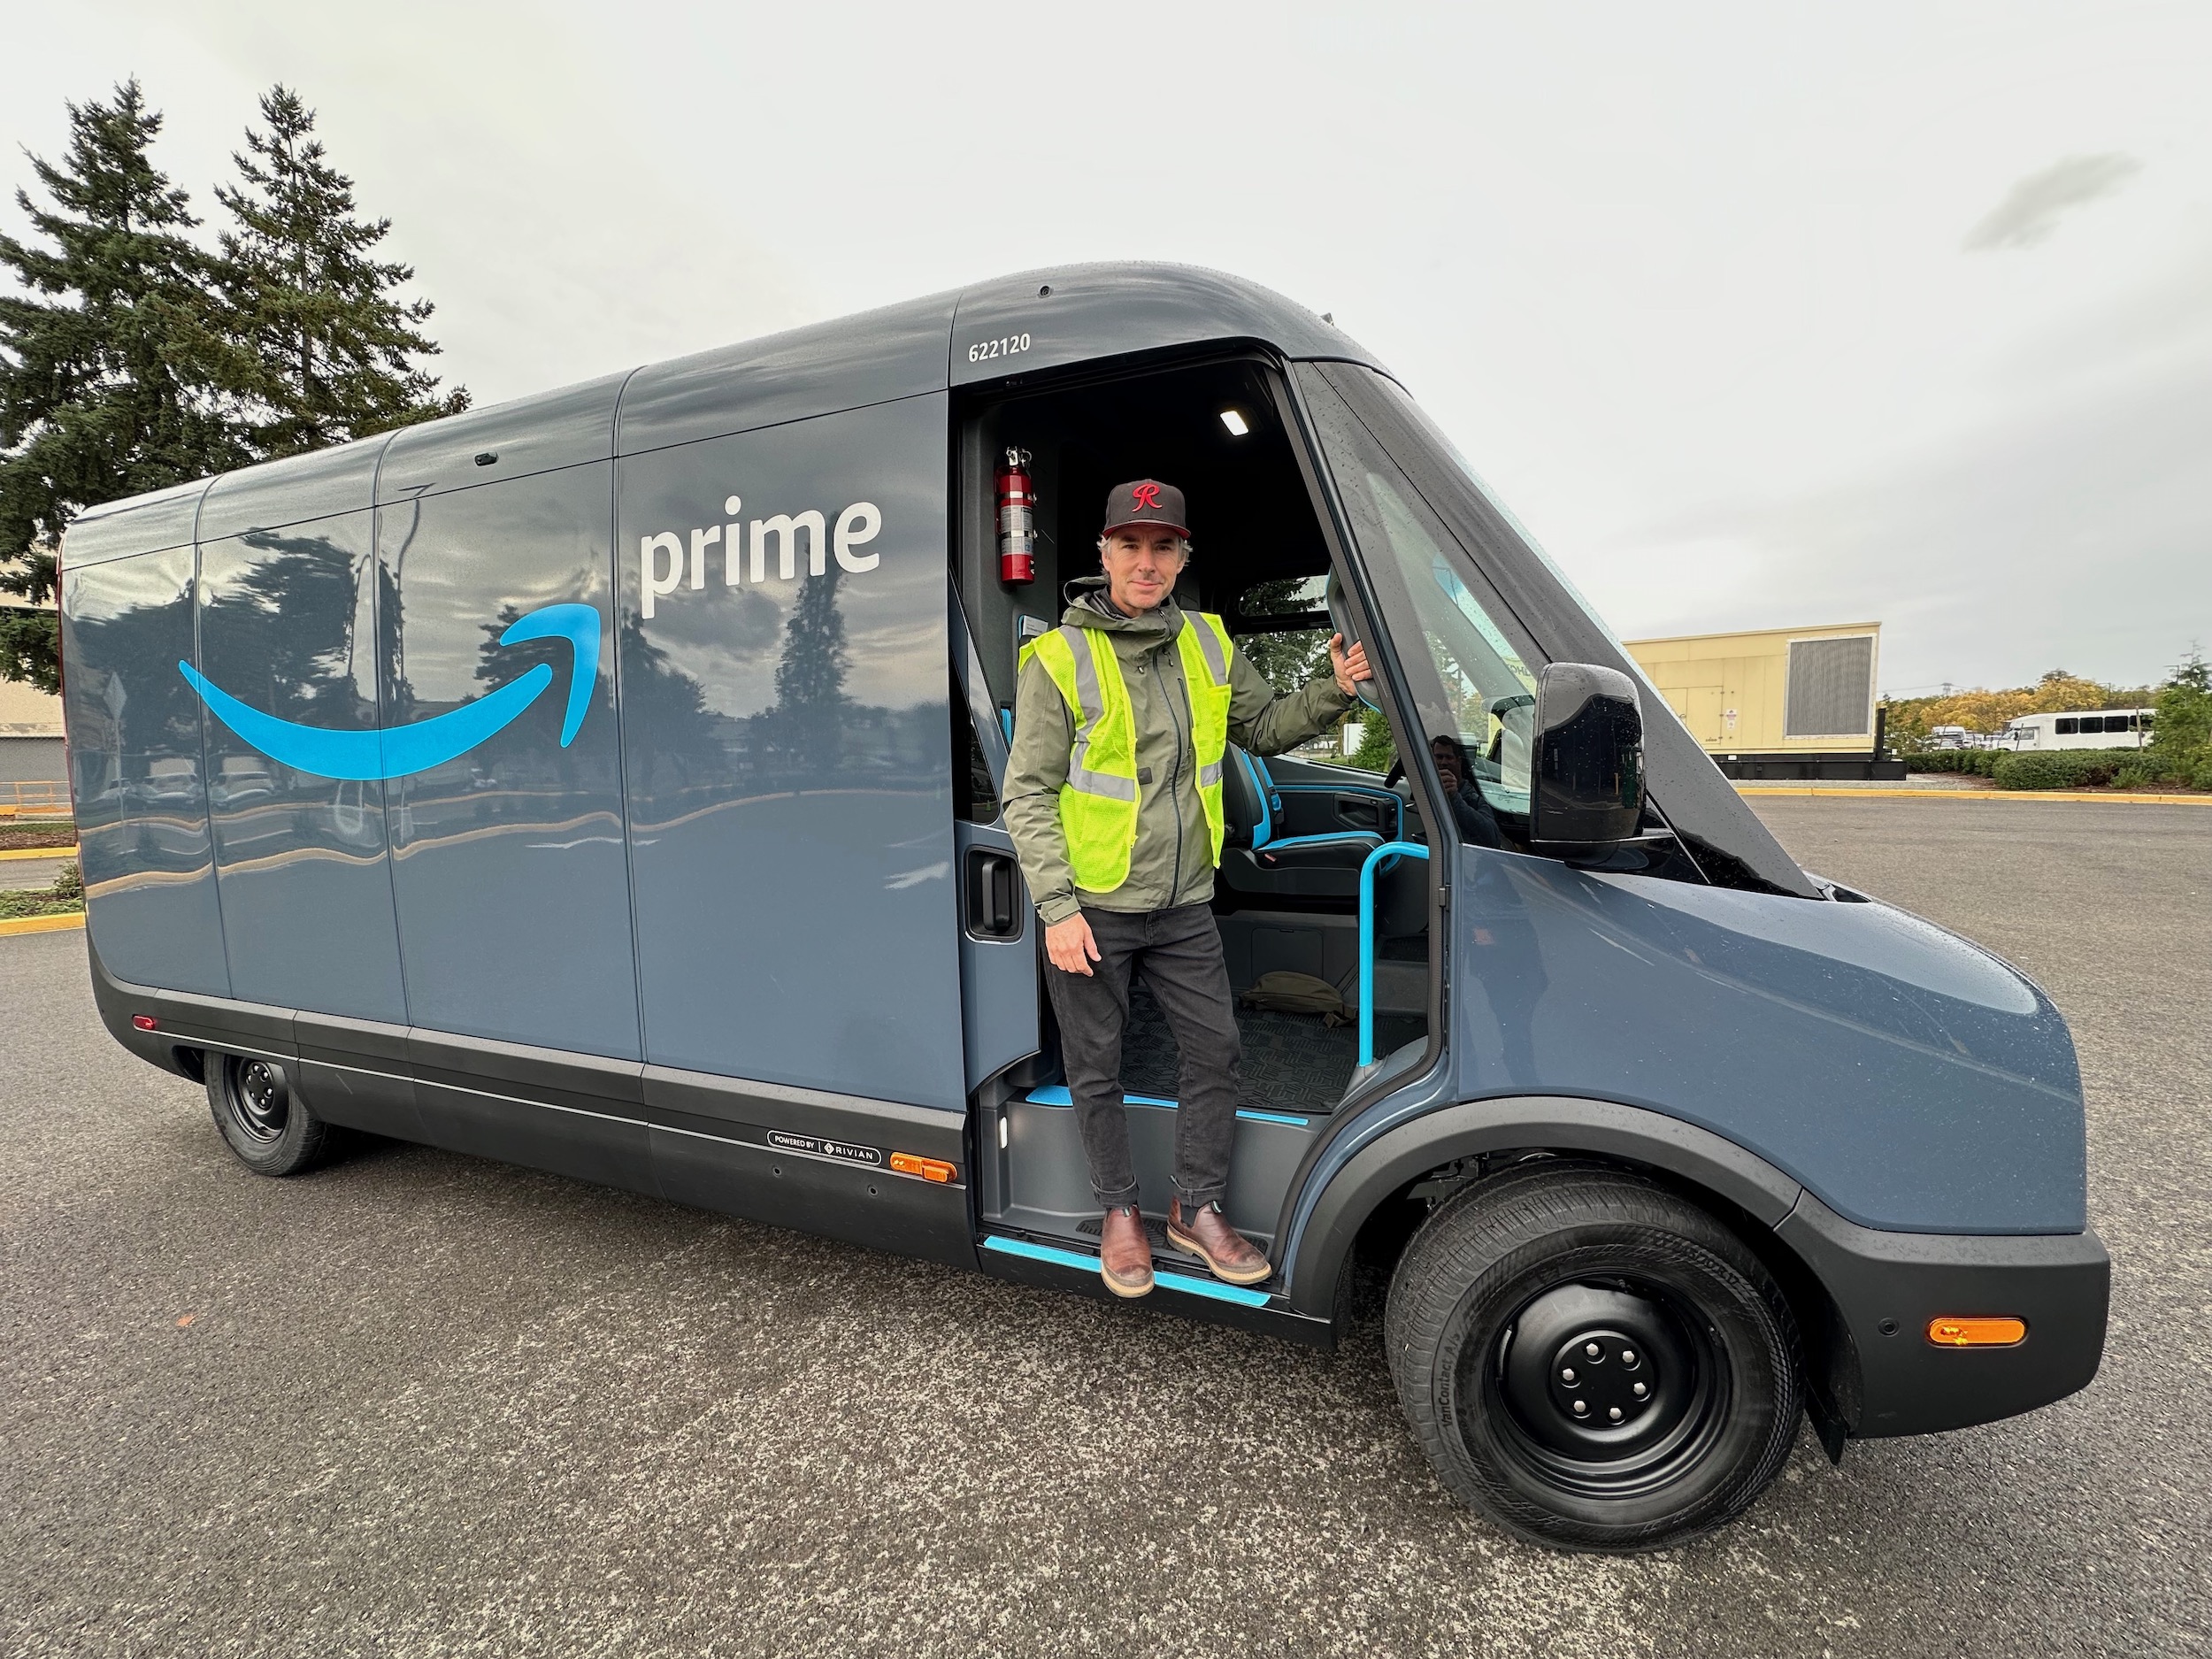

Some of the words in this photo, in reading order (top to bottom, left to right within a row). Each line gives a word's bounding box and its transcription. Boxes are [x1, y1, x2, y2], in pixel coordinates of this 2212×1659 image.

[968, 333, 1031, 363] 622120
[1132, 483, 1163, 512] R
[641, 495, 882, 619] prime
[774, 1135, 806, 1147] POWERED
[835, 1146, 873, 1160] RIVIAN
[1438, 1358, 1453, 1427] VanContact
